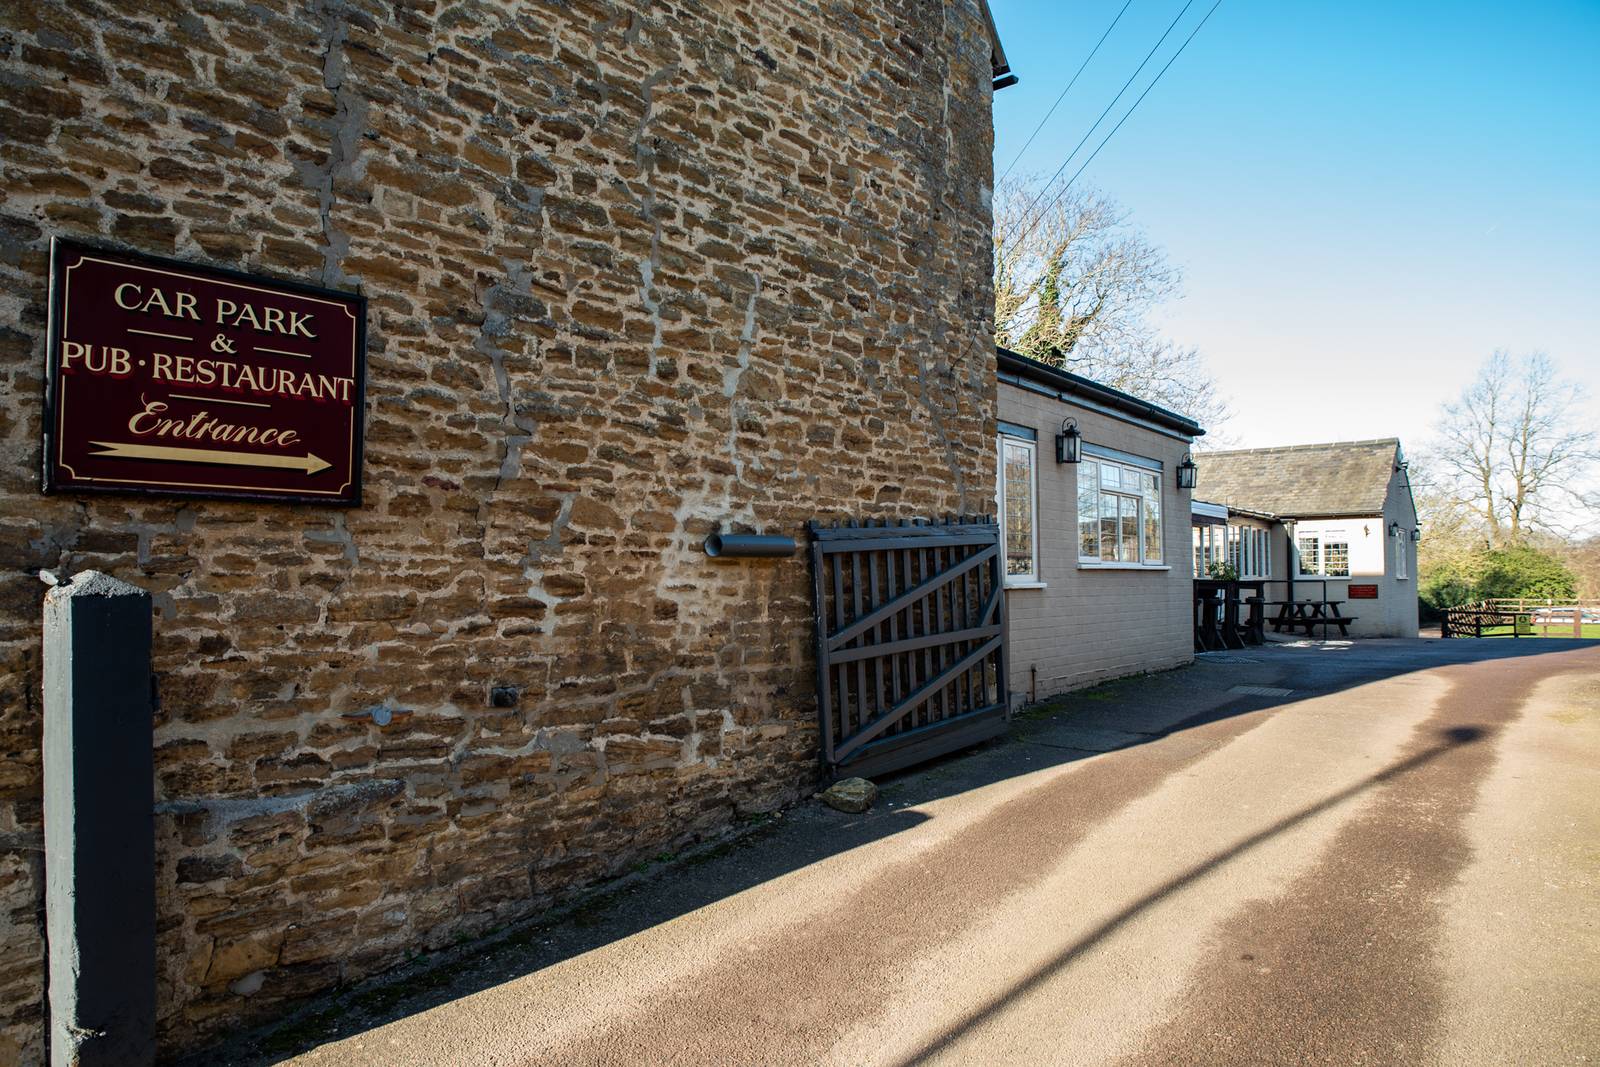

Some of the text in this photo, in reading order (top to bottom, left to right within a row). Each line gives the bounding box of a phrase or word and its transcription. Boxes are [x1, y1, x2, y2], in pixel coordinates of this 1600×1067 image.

[114, 283, 317, 338] CAR PARK
[210, 333, 237, 354] &
[60, 341, 354, 401] PUB RESTAURANT
[128, 392, 301, 446] Entrance
